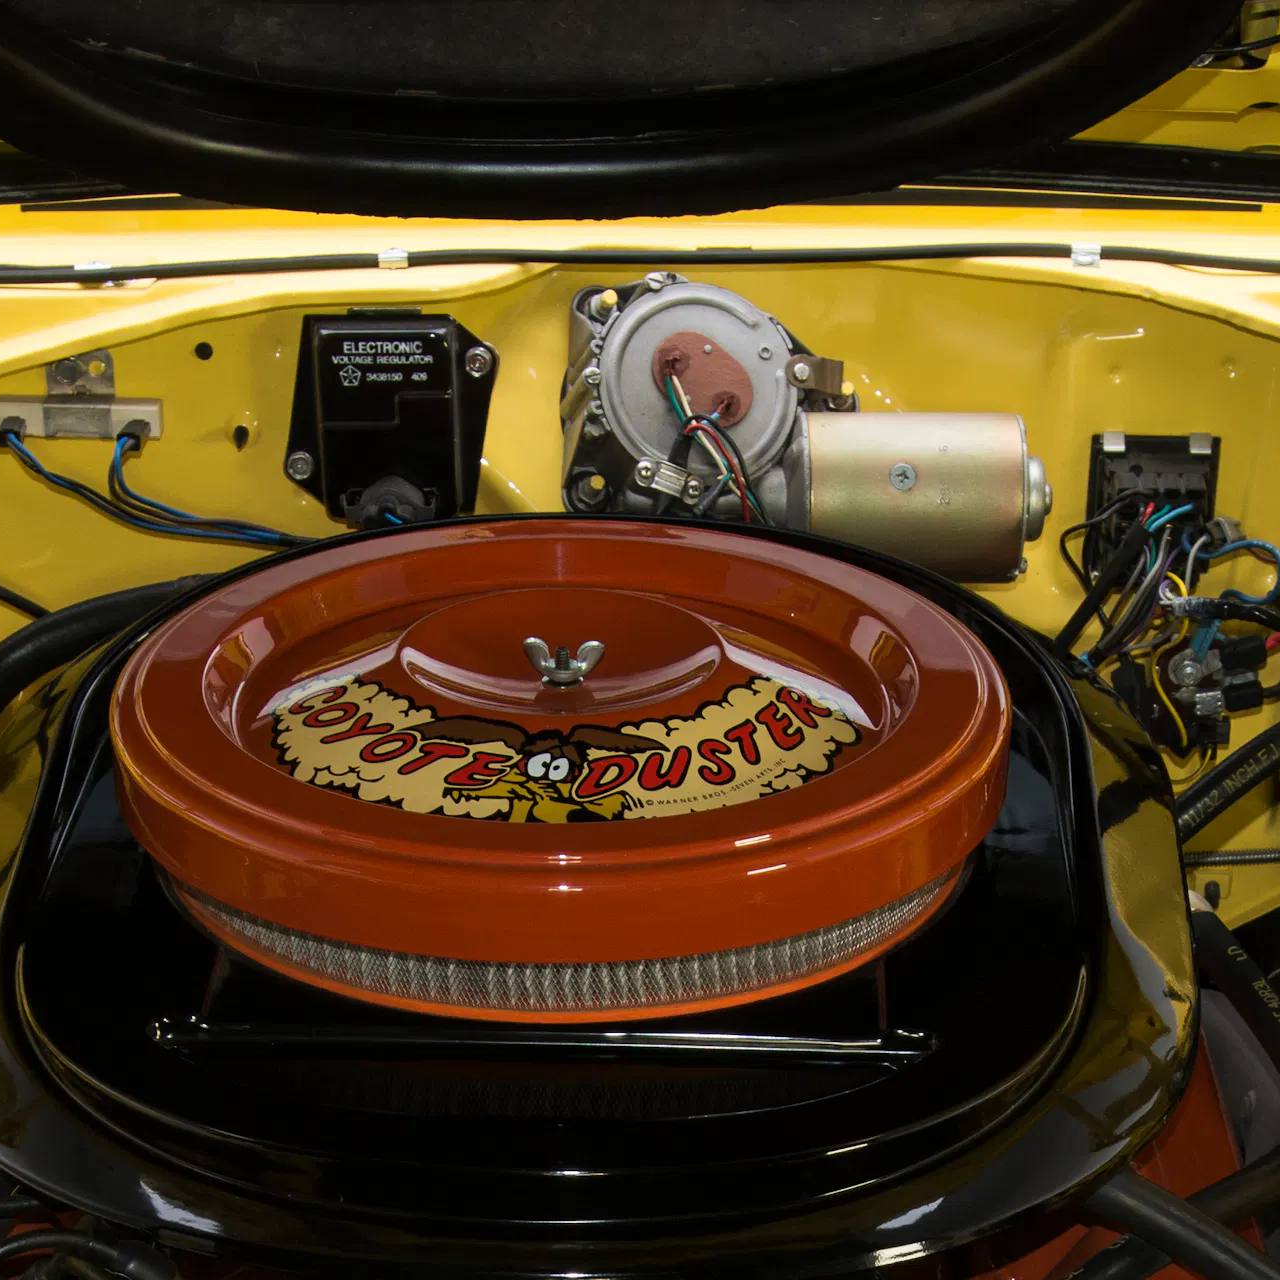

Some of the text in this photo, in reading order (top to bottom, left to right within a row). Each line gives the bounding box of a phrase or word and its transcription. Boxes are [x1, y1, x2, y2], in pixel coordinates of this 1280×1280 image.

[343, 341, 423, 354] ELECTRONIC
[332, 355, 434, 364] VOLTAGE REGULATOR
[288, 685, 834, 802] COYOTE DUSTER
[1222, 759, 1259, 795] INCH
[657, 796, 699, 806] WARNER
